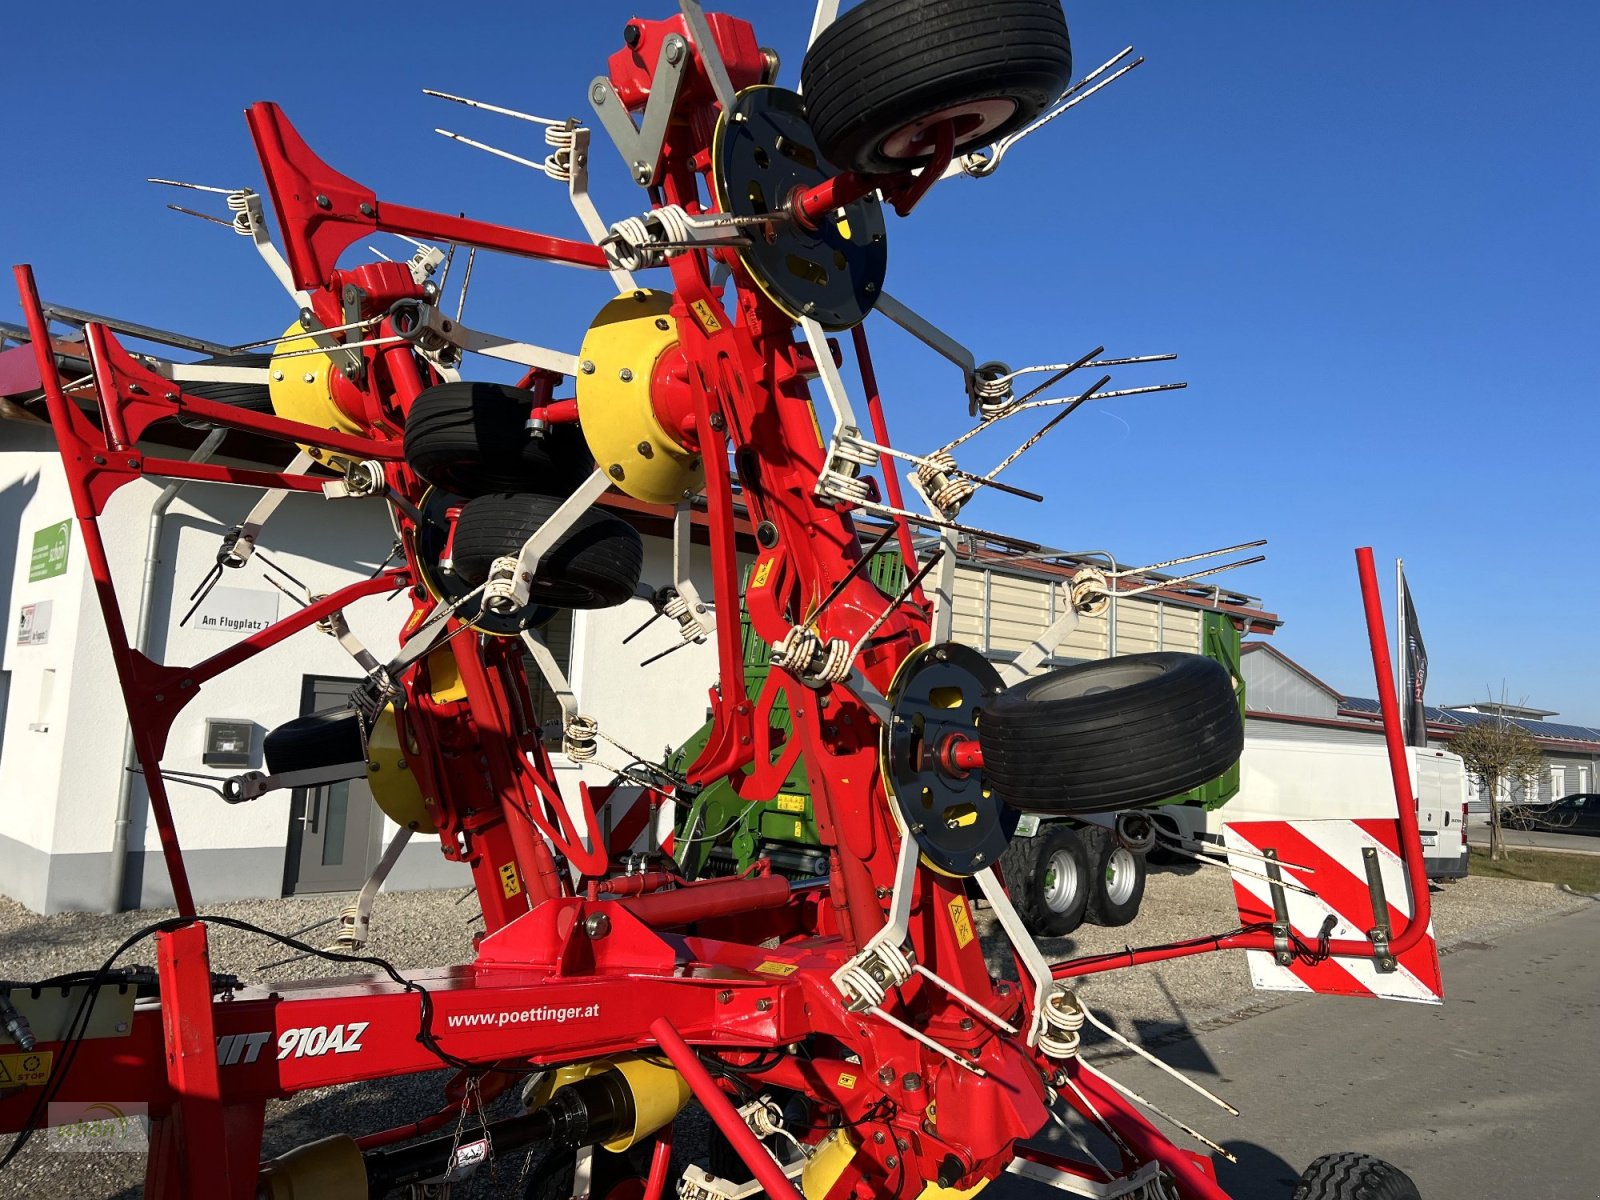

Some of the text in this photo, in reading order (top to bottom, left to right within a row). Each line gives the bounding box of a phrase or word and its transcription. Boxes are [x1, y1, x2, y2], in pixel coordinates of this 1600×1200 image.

[202, 615, 217, 626] Am
[220, 616, 262, 630] Flugplatz
[447, 1003, 600, 1027] www.poettinger.at
[16, 1072, 45, 1081] STOP
